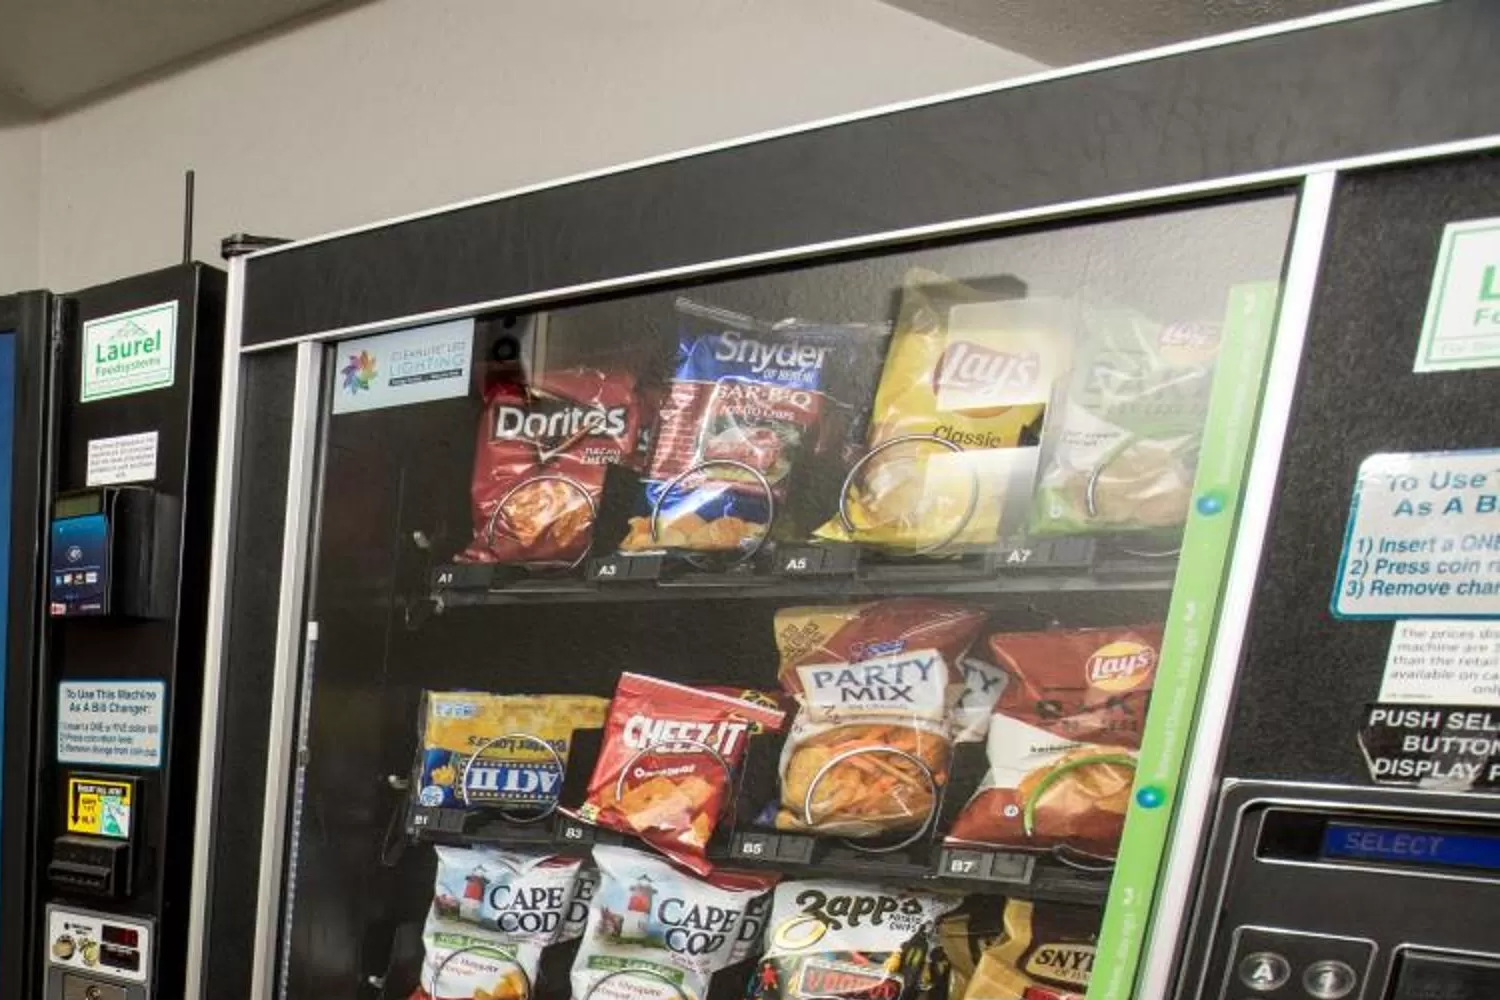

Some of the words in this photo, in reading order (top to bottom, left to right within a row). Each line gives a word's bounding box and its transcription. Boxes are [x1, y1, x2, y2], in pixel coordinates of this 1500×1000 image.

[96, 328, 161, 363] Laurel
[496, 407, 625, 438] Doritos
[932, 425, 1000, 448] Classic
[1388, 475, 1418, 492] To
[1430, 471, 1487, 490] Use
[1393, 499, 1432, 517] As
[1442, 497, 1463, 515] A
[1007, 549, 1032, 562] A7
[1356, 536, 1373, 557] 1)
[1379, 536, 1436, 553] Insert
[599, 566, 617, 577] A3
[786, 558, 807, 570] A5
[1350, 559, 1368, 579] 2)
[1374, 559, 1430, 575] Press
[1437, 557, 1480, 574] coin
[437, 573, 453, 583] A1
[1346, 580, 1363, 599] 3)
[1370, 579, 1449, 596] Remove
[811, 657, 937, 689] PARTY
[841, 686, 914, 704] MIX
[1369, 709, 1441, 729] PUSH
[1446, 712, 1500, 731] SEL
[467, 767, 499, 790] II
[1375, 758, 1482, 779] DISPLAY
[503, 768, 558, 793] ACT
[743, 842, 762, 855] B5
[1345, 832, 1444, 856] SELECT
[950, 860, 973, 873] B7
[490, 885, 565, 911] CAPE
[497, 911, 561, 933] COD
[658, 898, 741, 932] CAPE
[1252, 962, 1273, 981] A
[1320, 972, 1334, 991] 1
